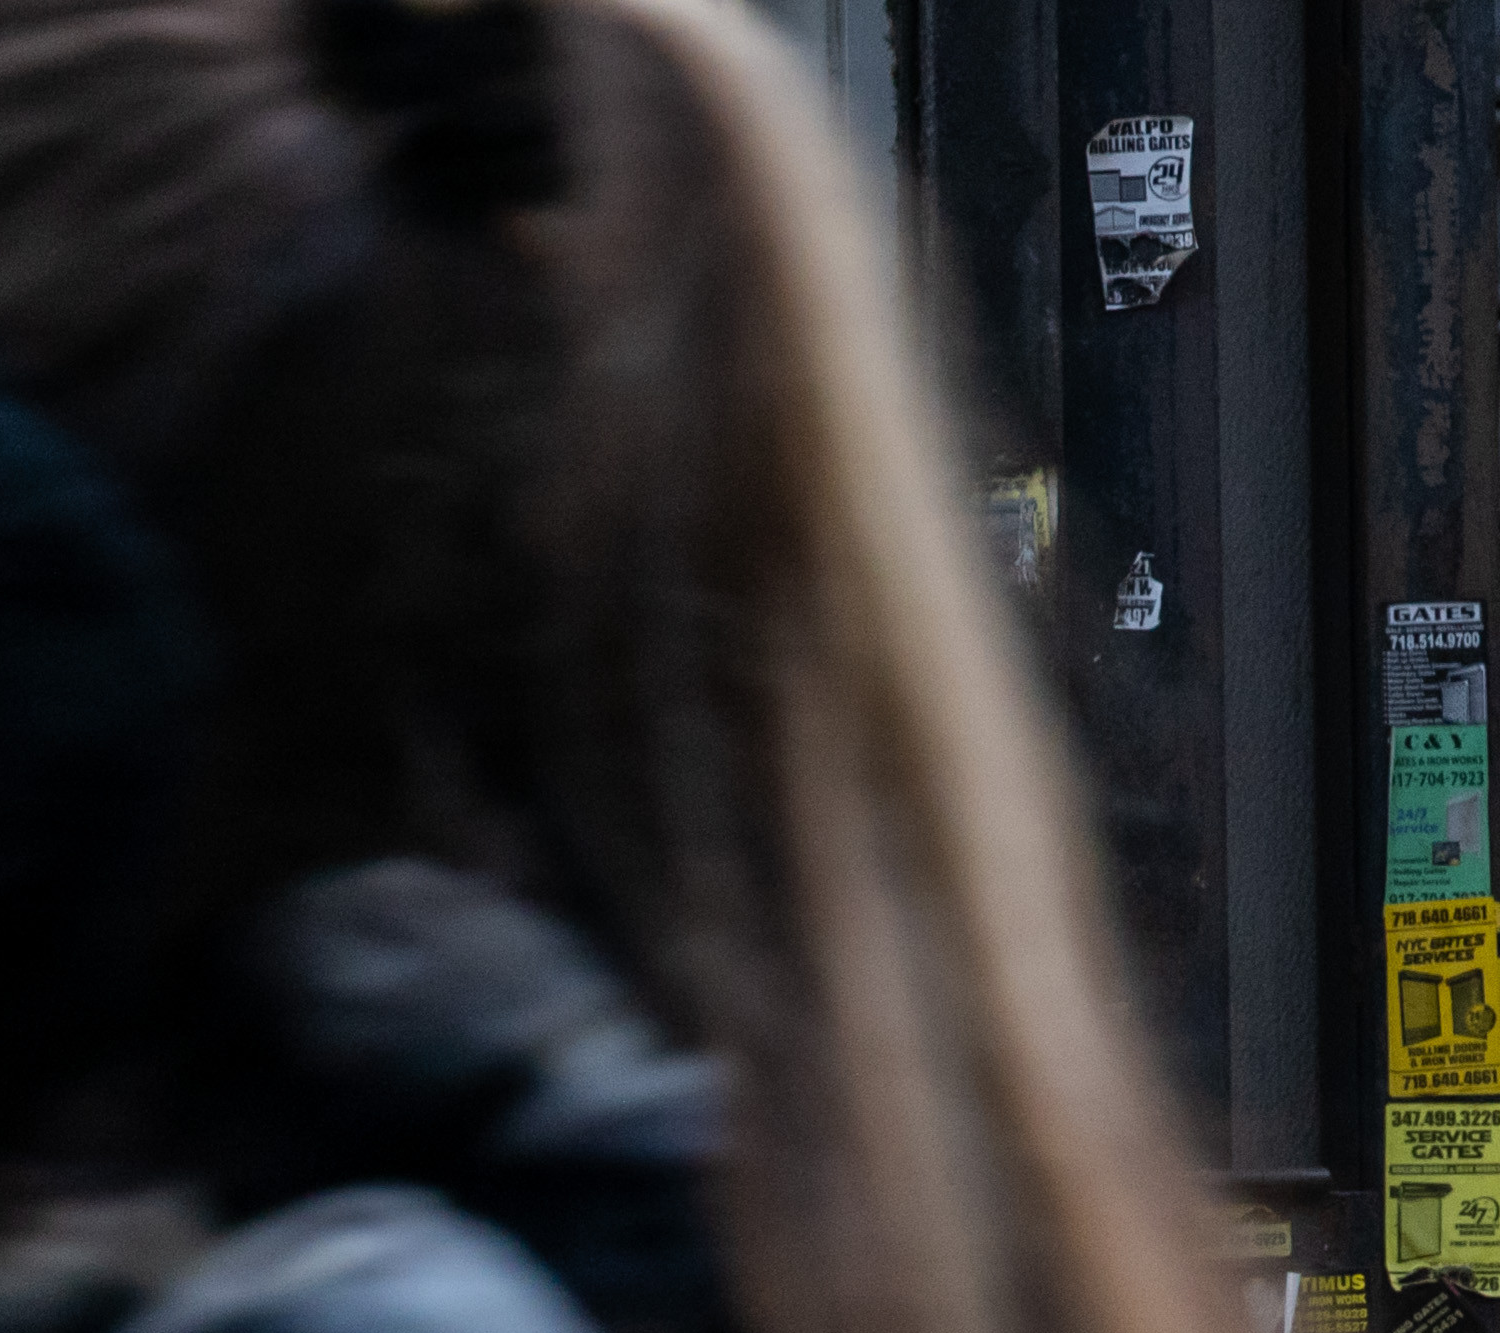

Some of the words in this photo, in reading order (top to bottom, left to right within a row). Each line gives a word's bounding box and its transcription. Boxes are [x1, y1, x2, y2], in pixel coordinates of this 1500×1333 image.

[1149, 135, 1190, 151] GATES
[1394, 606, 1475, 620] GATES
[1389, 632, 1480, 650] 718.514.9700
[1392, 905, 1487, 927] 718.640.4661
[1396, 938, 1427, 952] NYC
[1430, 933, 1485, 949] GATES
[1403, 949, 1475, 965] SERVICES
[1405, 1130, 1492, 1143] SERVICE
[1412, 1145, 1485, 1159] GATES
